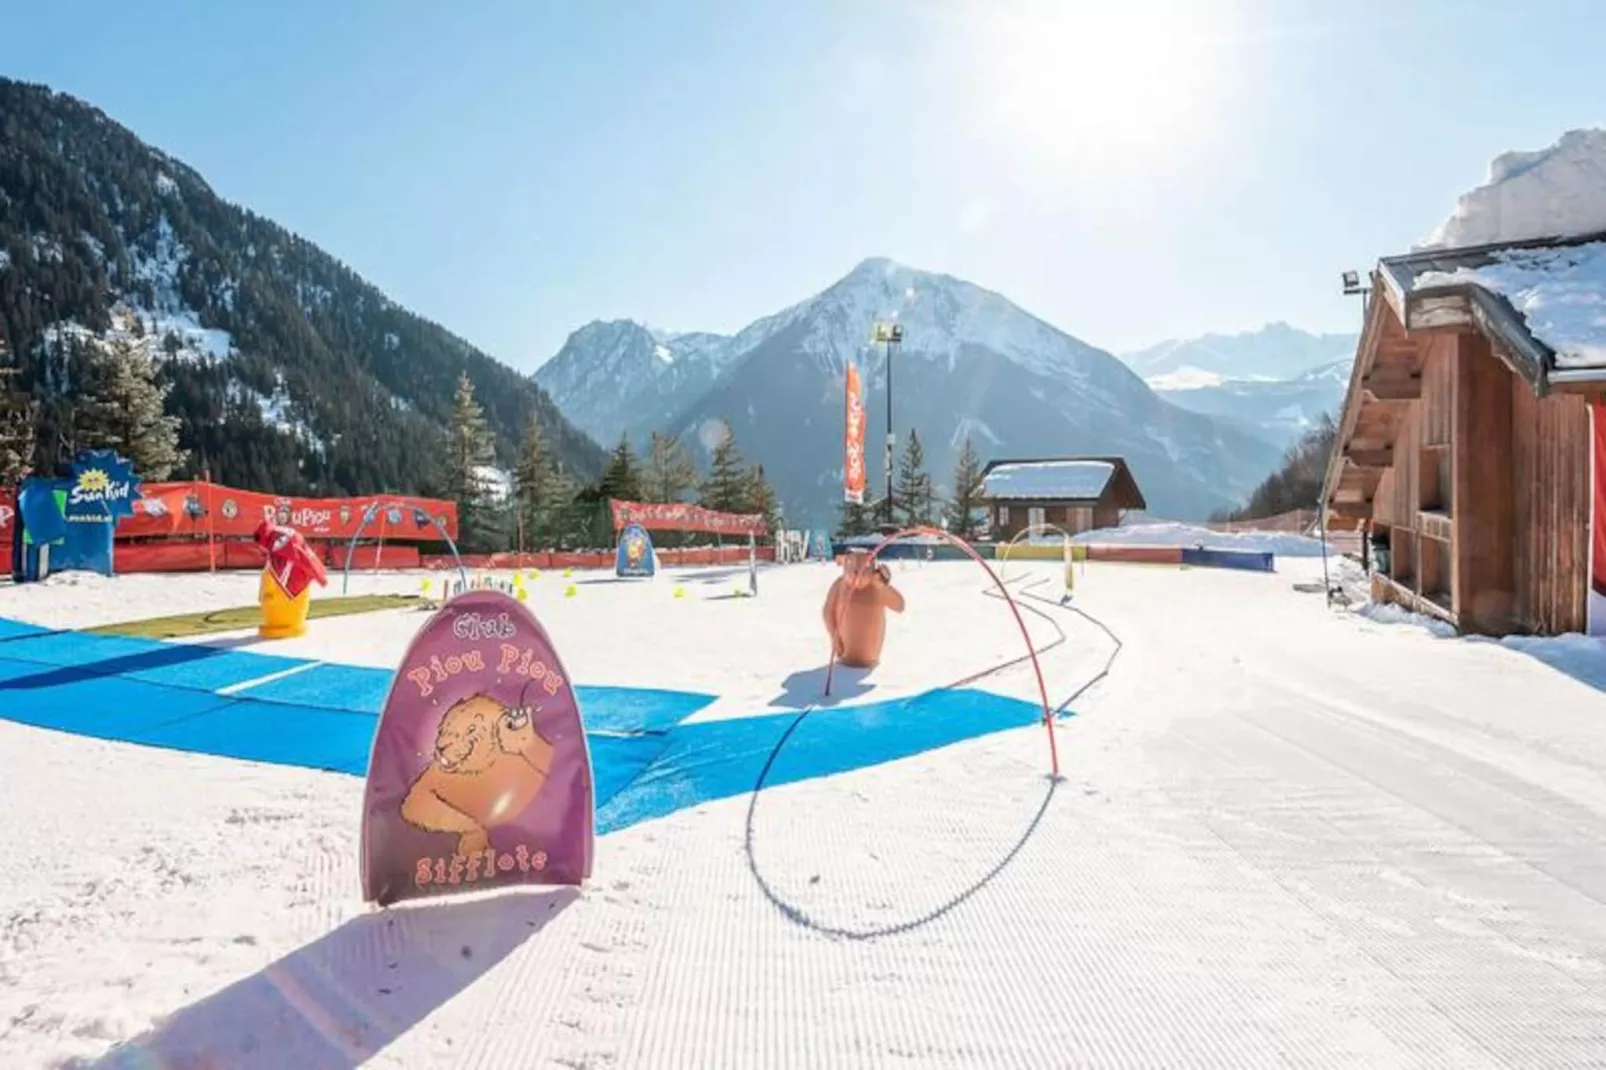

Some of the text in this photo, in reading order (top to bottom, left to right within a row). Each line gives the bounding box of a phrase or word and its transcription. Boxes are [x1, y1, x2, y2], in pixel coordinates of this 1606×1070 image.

[453, 612, 516, 639] Club
[407, 643, 564, 697] Piou Piou
[415, 844, 547, 884] Sifflote
